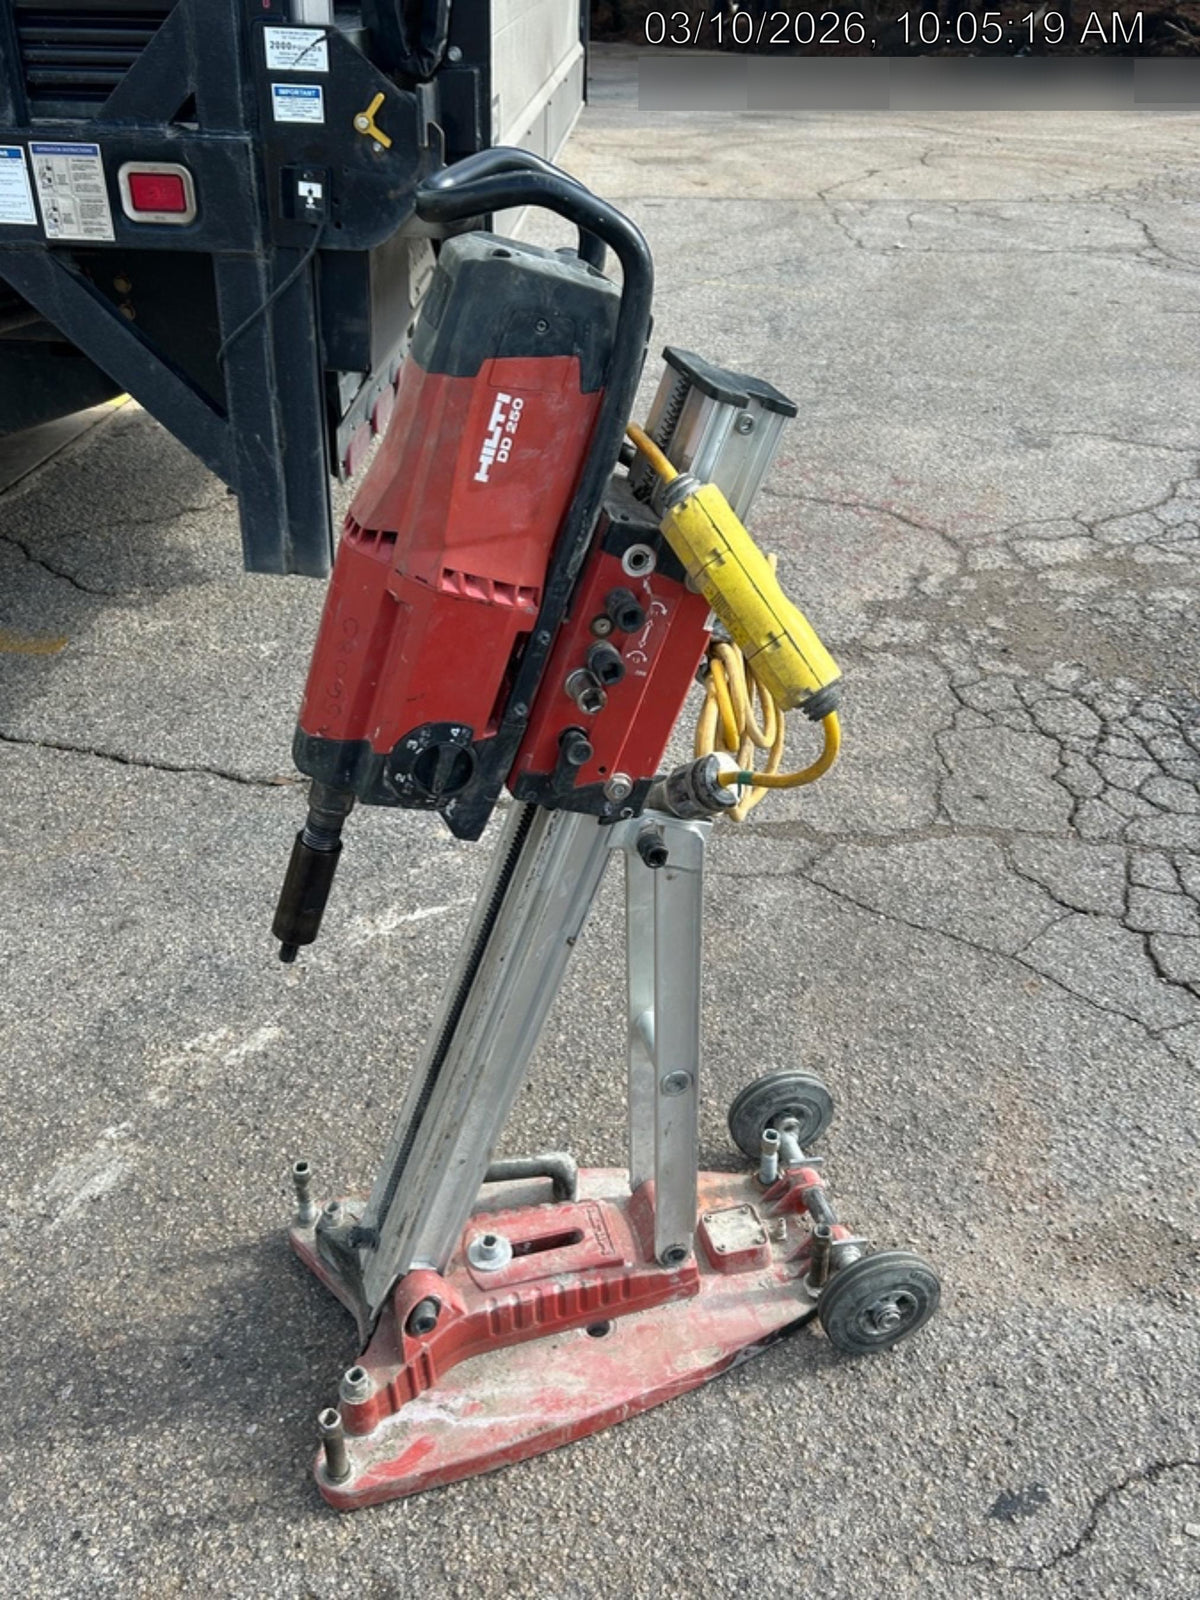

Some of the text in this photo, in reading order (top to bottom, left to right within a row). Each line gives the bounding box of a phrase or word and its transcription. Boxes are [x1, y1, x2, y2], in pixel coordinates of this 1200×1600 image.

[473, 392, 512, 483] HILTI
[496, 398, 524, 463] DD 250
